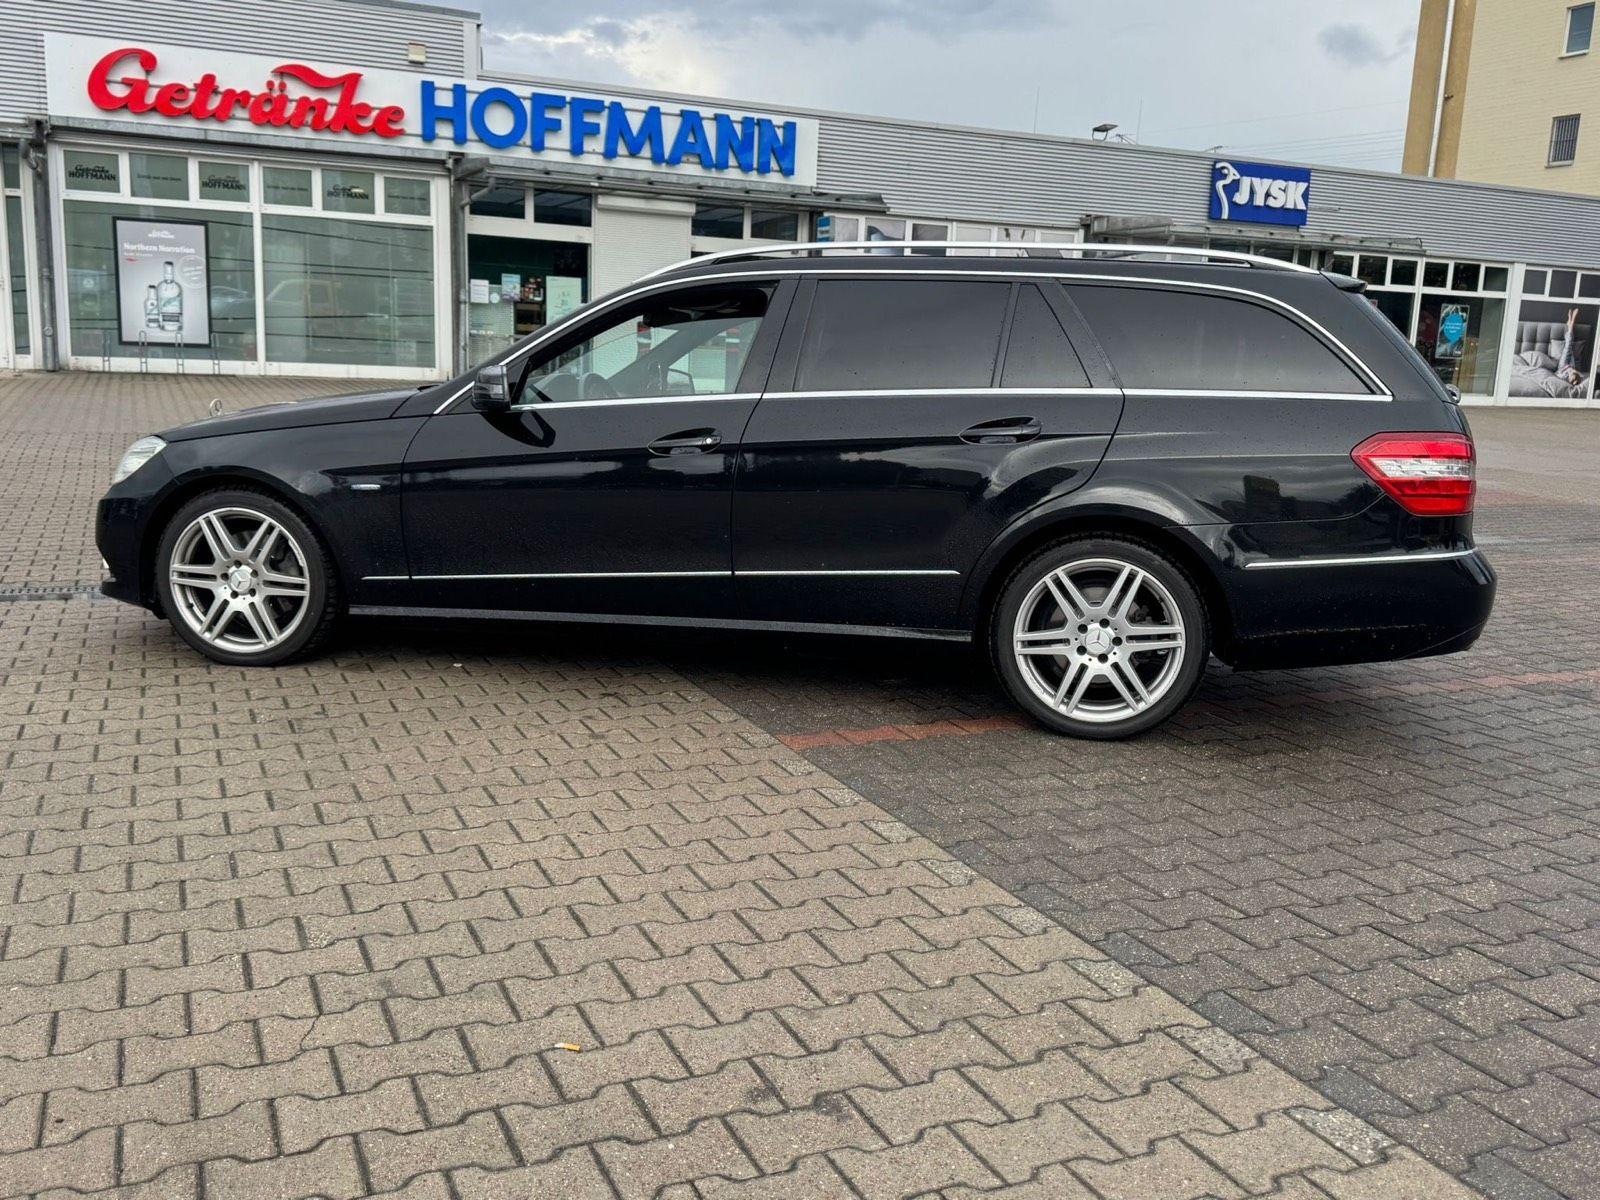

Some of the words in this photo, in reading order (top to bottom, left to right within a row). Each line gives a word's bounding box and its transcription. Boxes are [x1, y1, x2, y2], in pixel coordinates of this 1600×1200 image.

[87, 47, 406, 138] Getränke
[420, 79, 796, 177] HOFFMANN
[68, 170, 116, 181] HOFFMANN
[201, 180, 246, 190] HOFFMANN
[1232, 175, 1309, 211] JYSK
[123, 242, 158, 251] Northern
